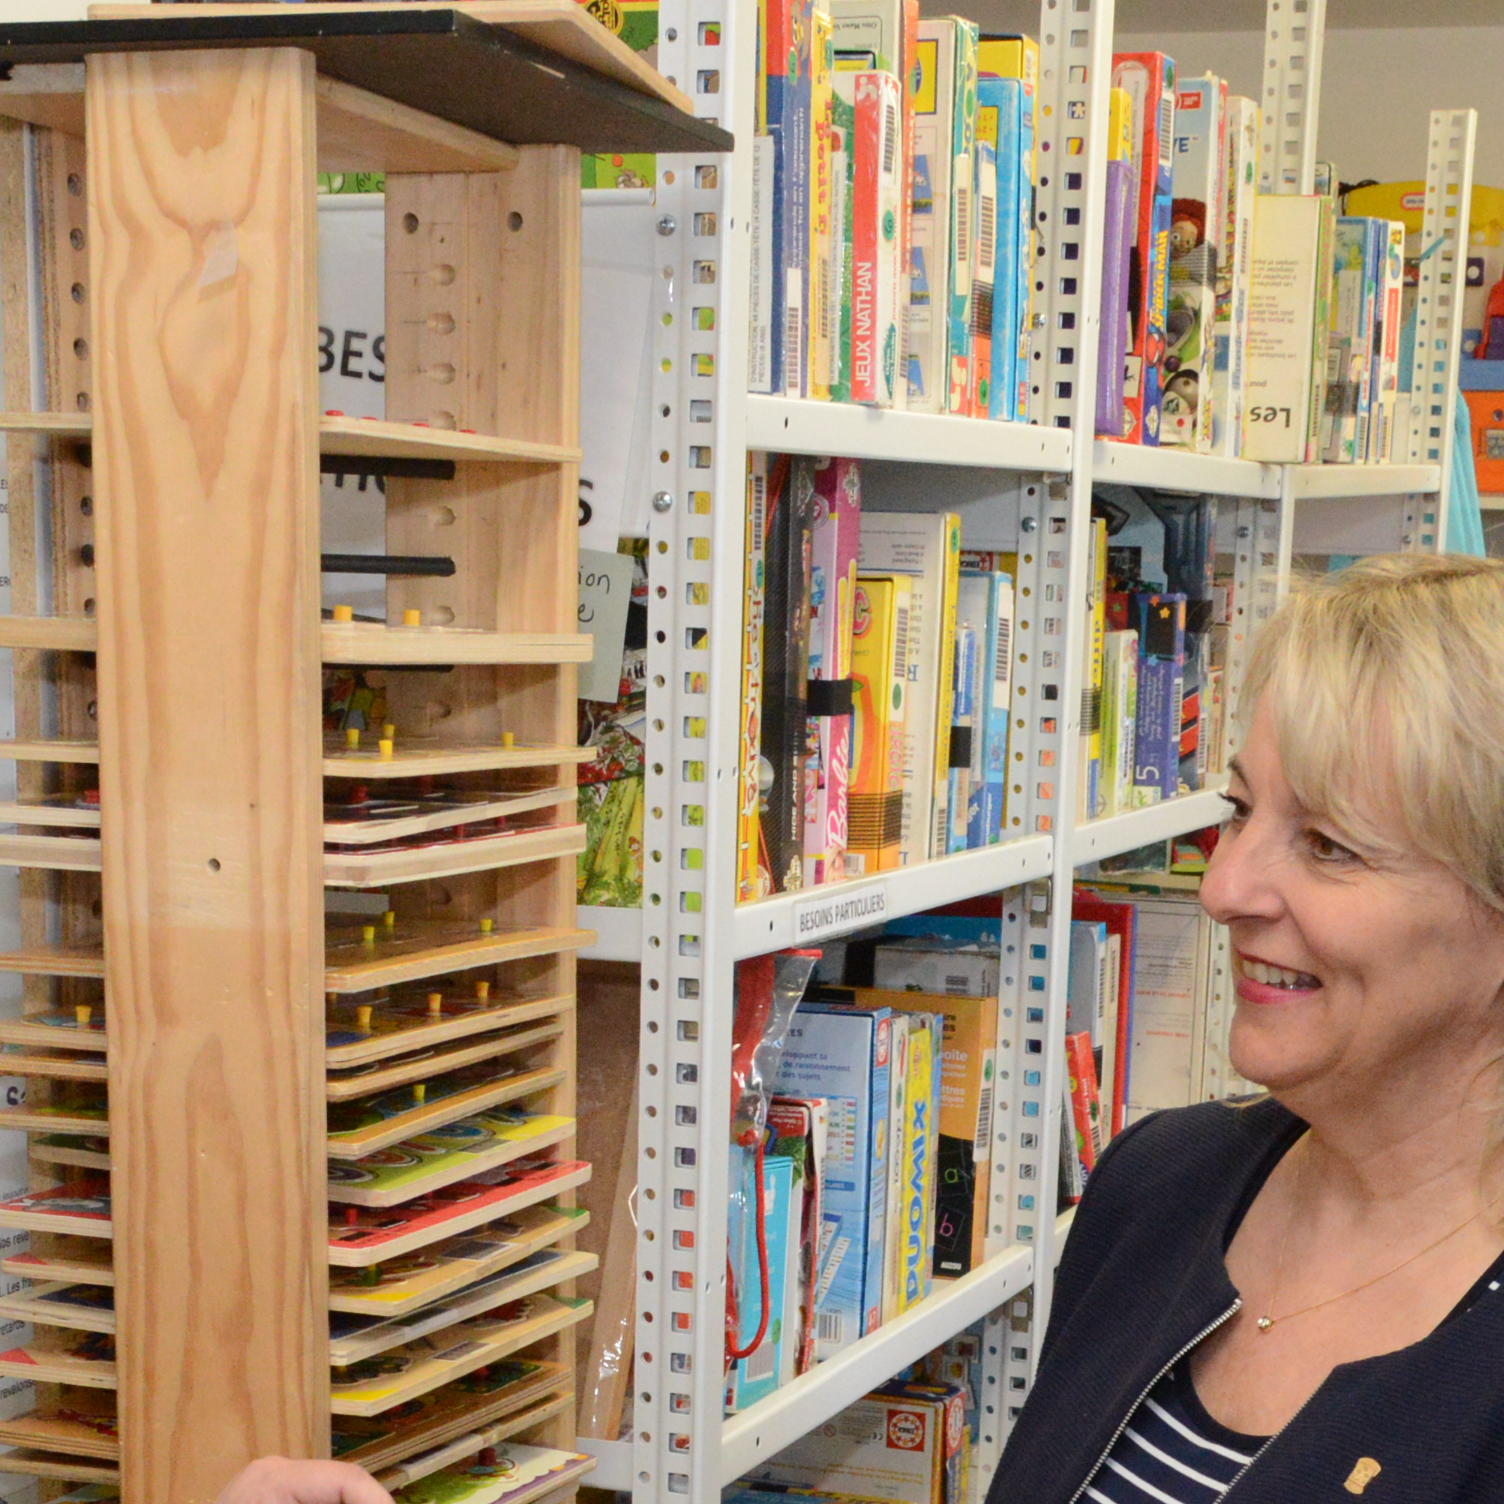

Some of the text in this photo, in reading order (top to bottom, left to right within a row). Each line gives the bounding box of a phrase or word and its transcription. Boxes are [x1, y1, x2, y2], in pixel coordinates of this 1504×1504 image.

[855, 261, 873, 387] JEUX NATHAN
[1249, 405, 1292, 429] Les
[826, 728, 850, 850] Barbie
[1135, 764, 1160, 781] 5
[799, 893, 885, 933] BESOINS PARTICULIERS
[906, 1100, 928, 1301] DUOMIX
